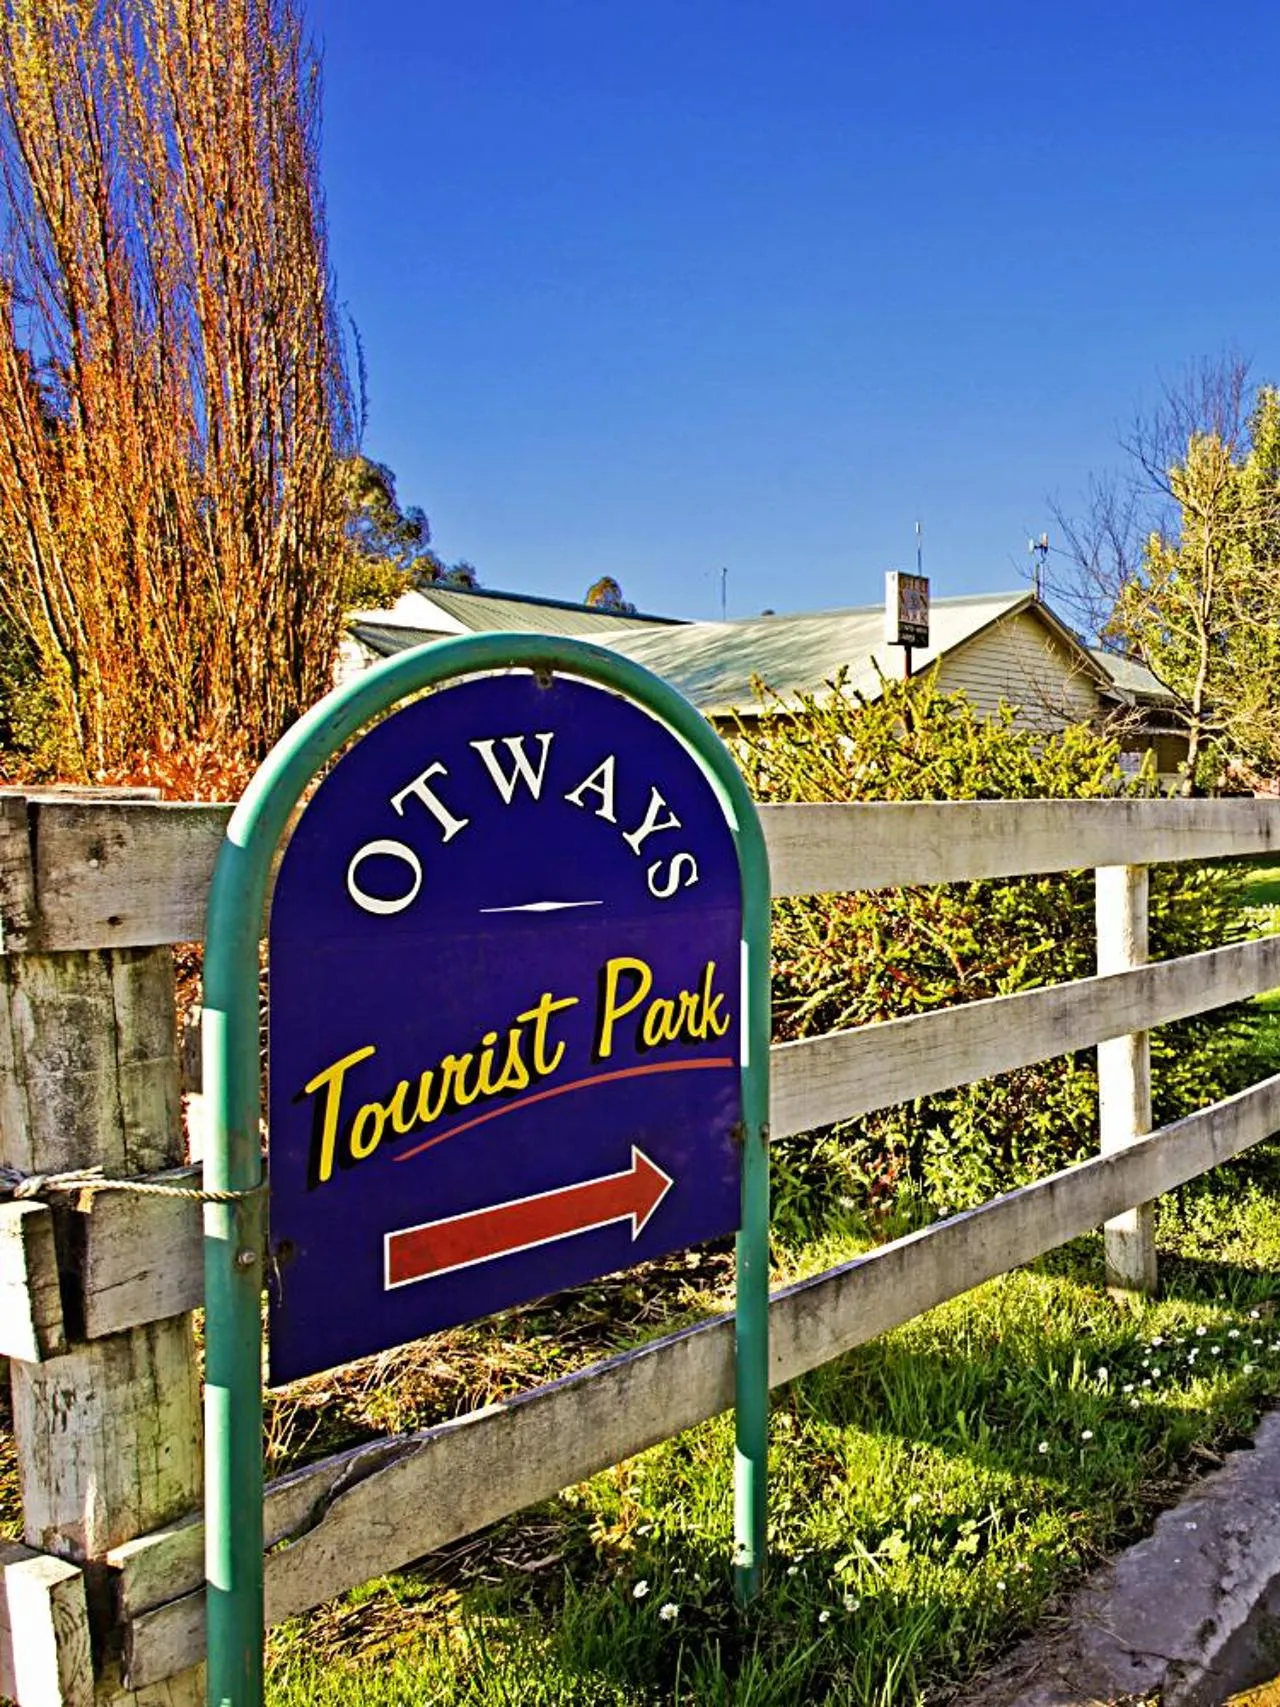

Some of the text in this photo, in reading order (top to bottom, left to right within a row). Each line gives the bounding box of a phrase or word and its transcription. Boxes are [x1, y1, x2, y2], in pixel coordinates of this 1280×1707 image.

[347, 732, 699, 915] OTWAYS
[304, 956, 731, 1183] Tourist Park
